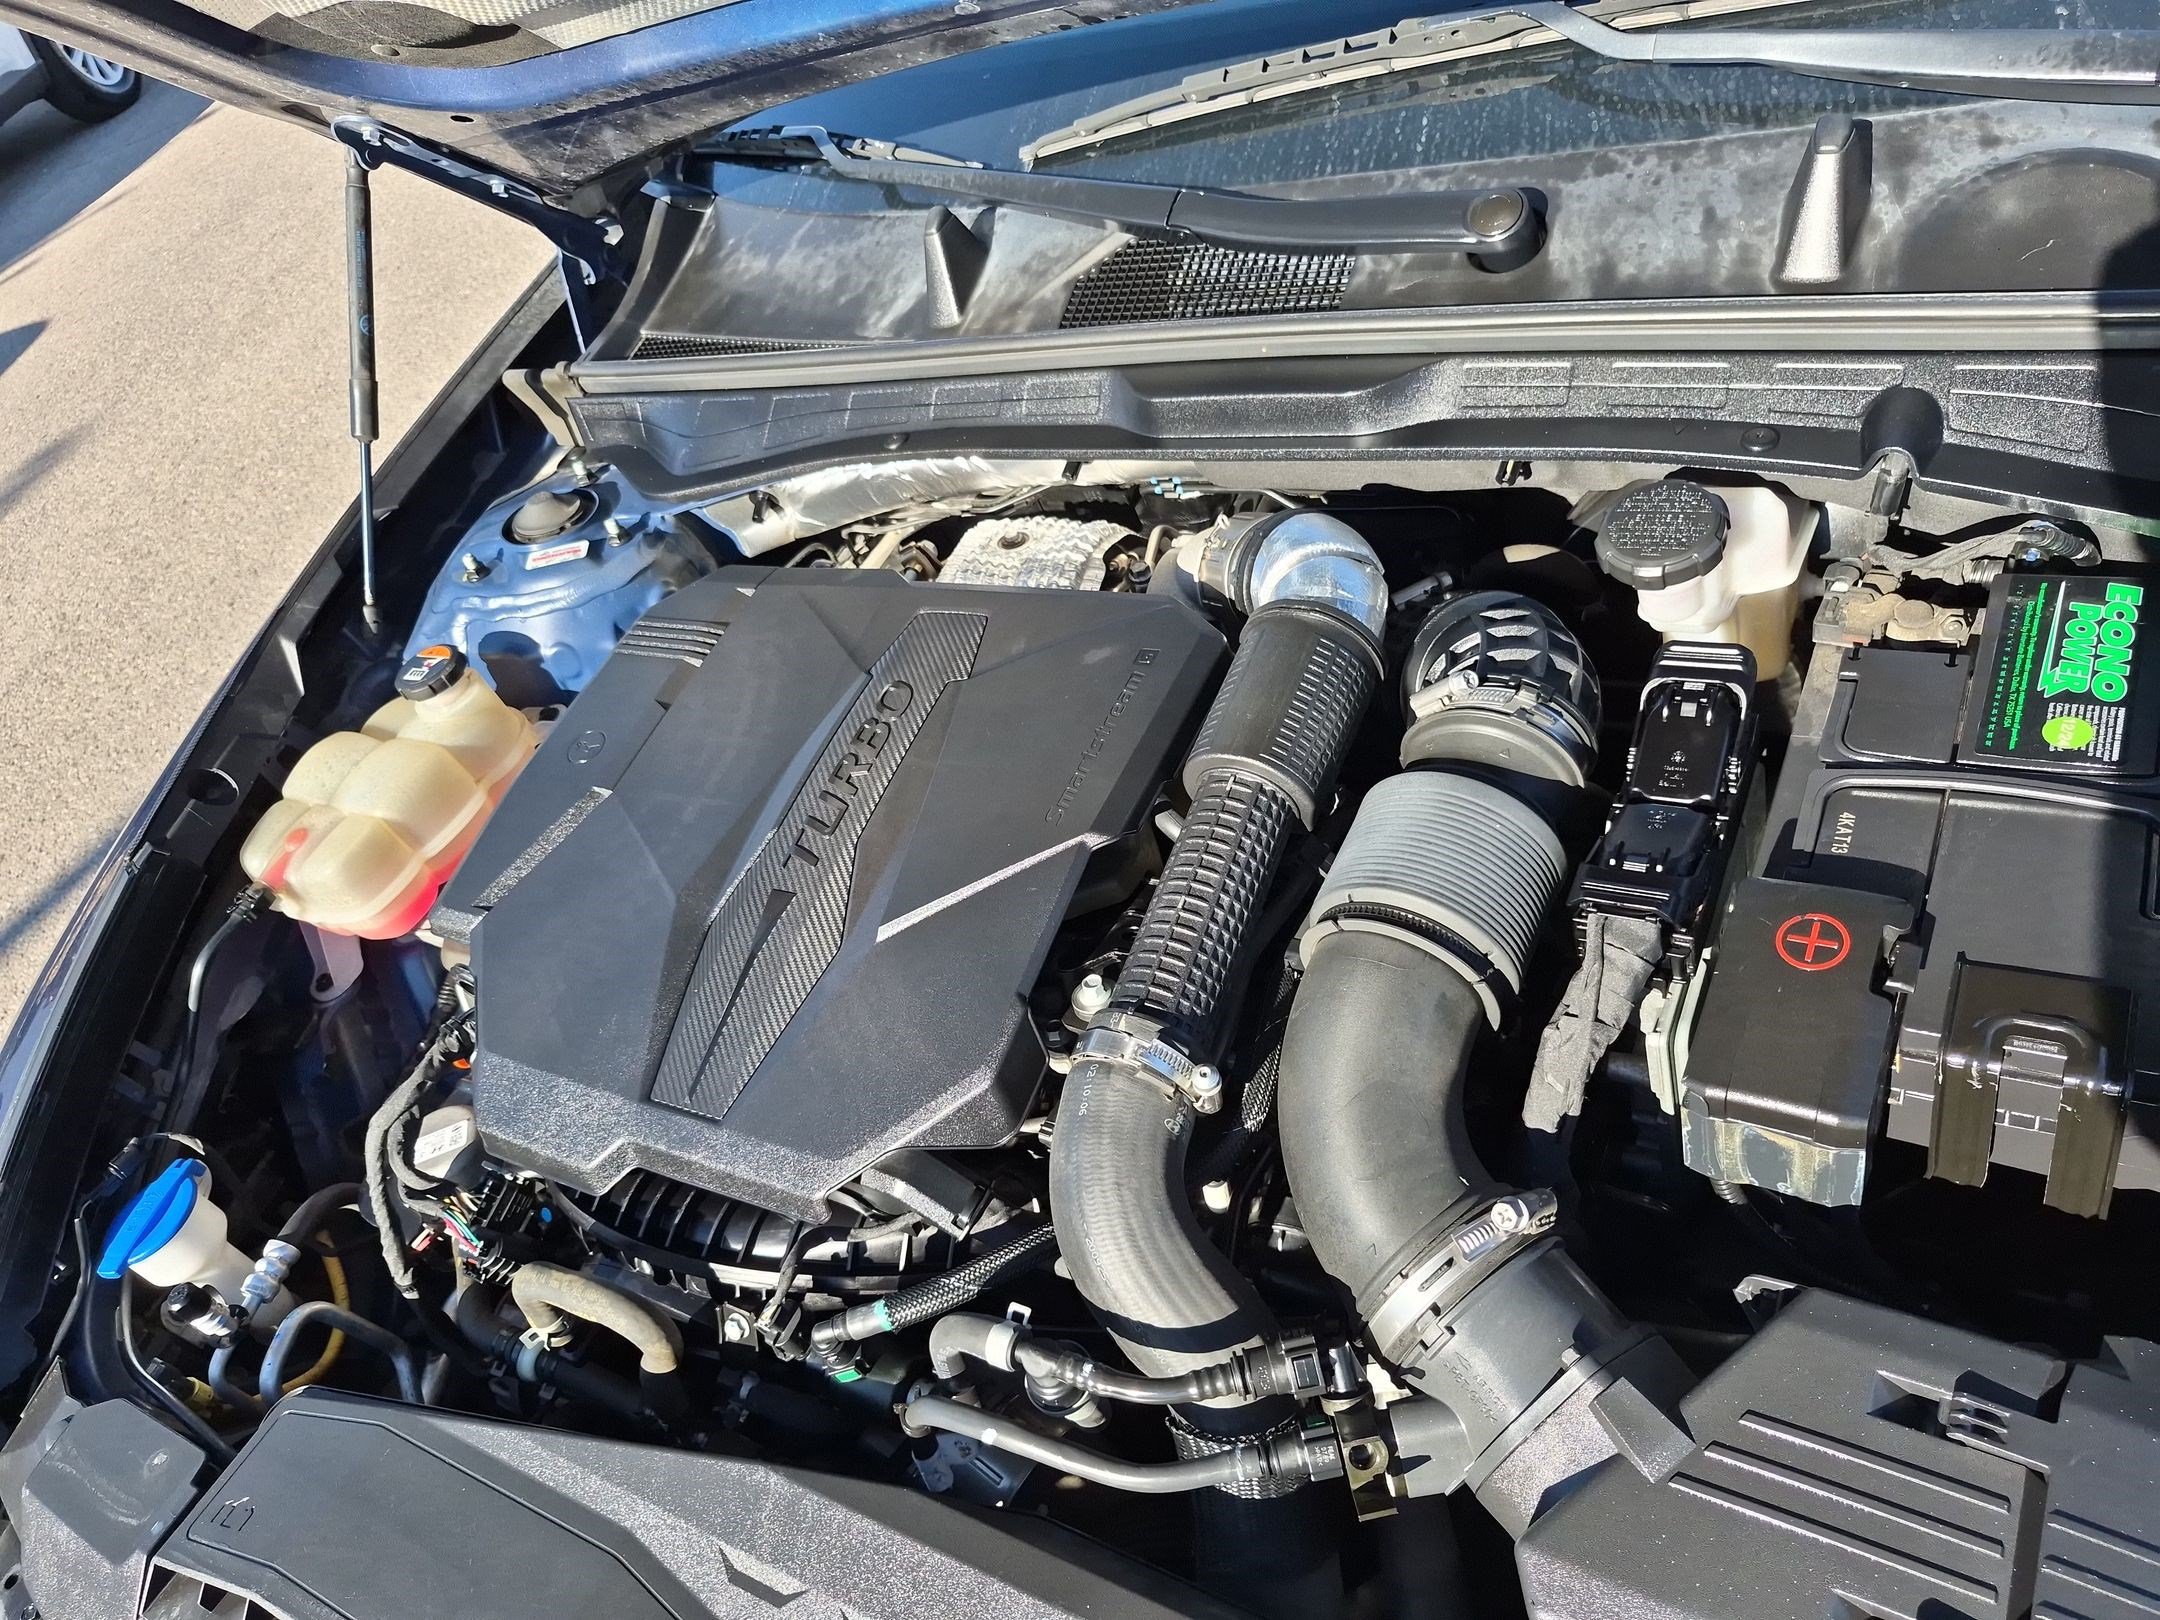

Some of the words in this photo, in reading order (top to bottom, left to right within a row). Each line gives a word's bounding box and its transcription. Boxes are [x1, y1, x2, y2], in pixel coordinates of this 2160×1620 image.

[2055, 601, 2104, 694] POWER
[2091, 582, 2144, 702] ECONO
[2005, 700, 2015, 716] 75251
[2008, 692, 2016, 701] TX
[2002, 715, 2012, 728] USA
[2057, 718, 2076, 748] 12/24
[1044, 670, 1146, 826] Smartstream
[781, 679, 914, 870] TURBO
[1831, 812, 1856, 854] 4KAT13
[1079, 1063, 1099, 1116] 02:10:06
